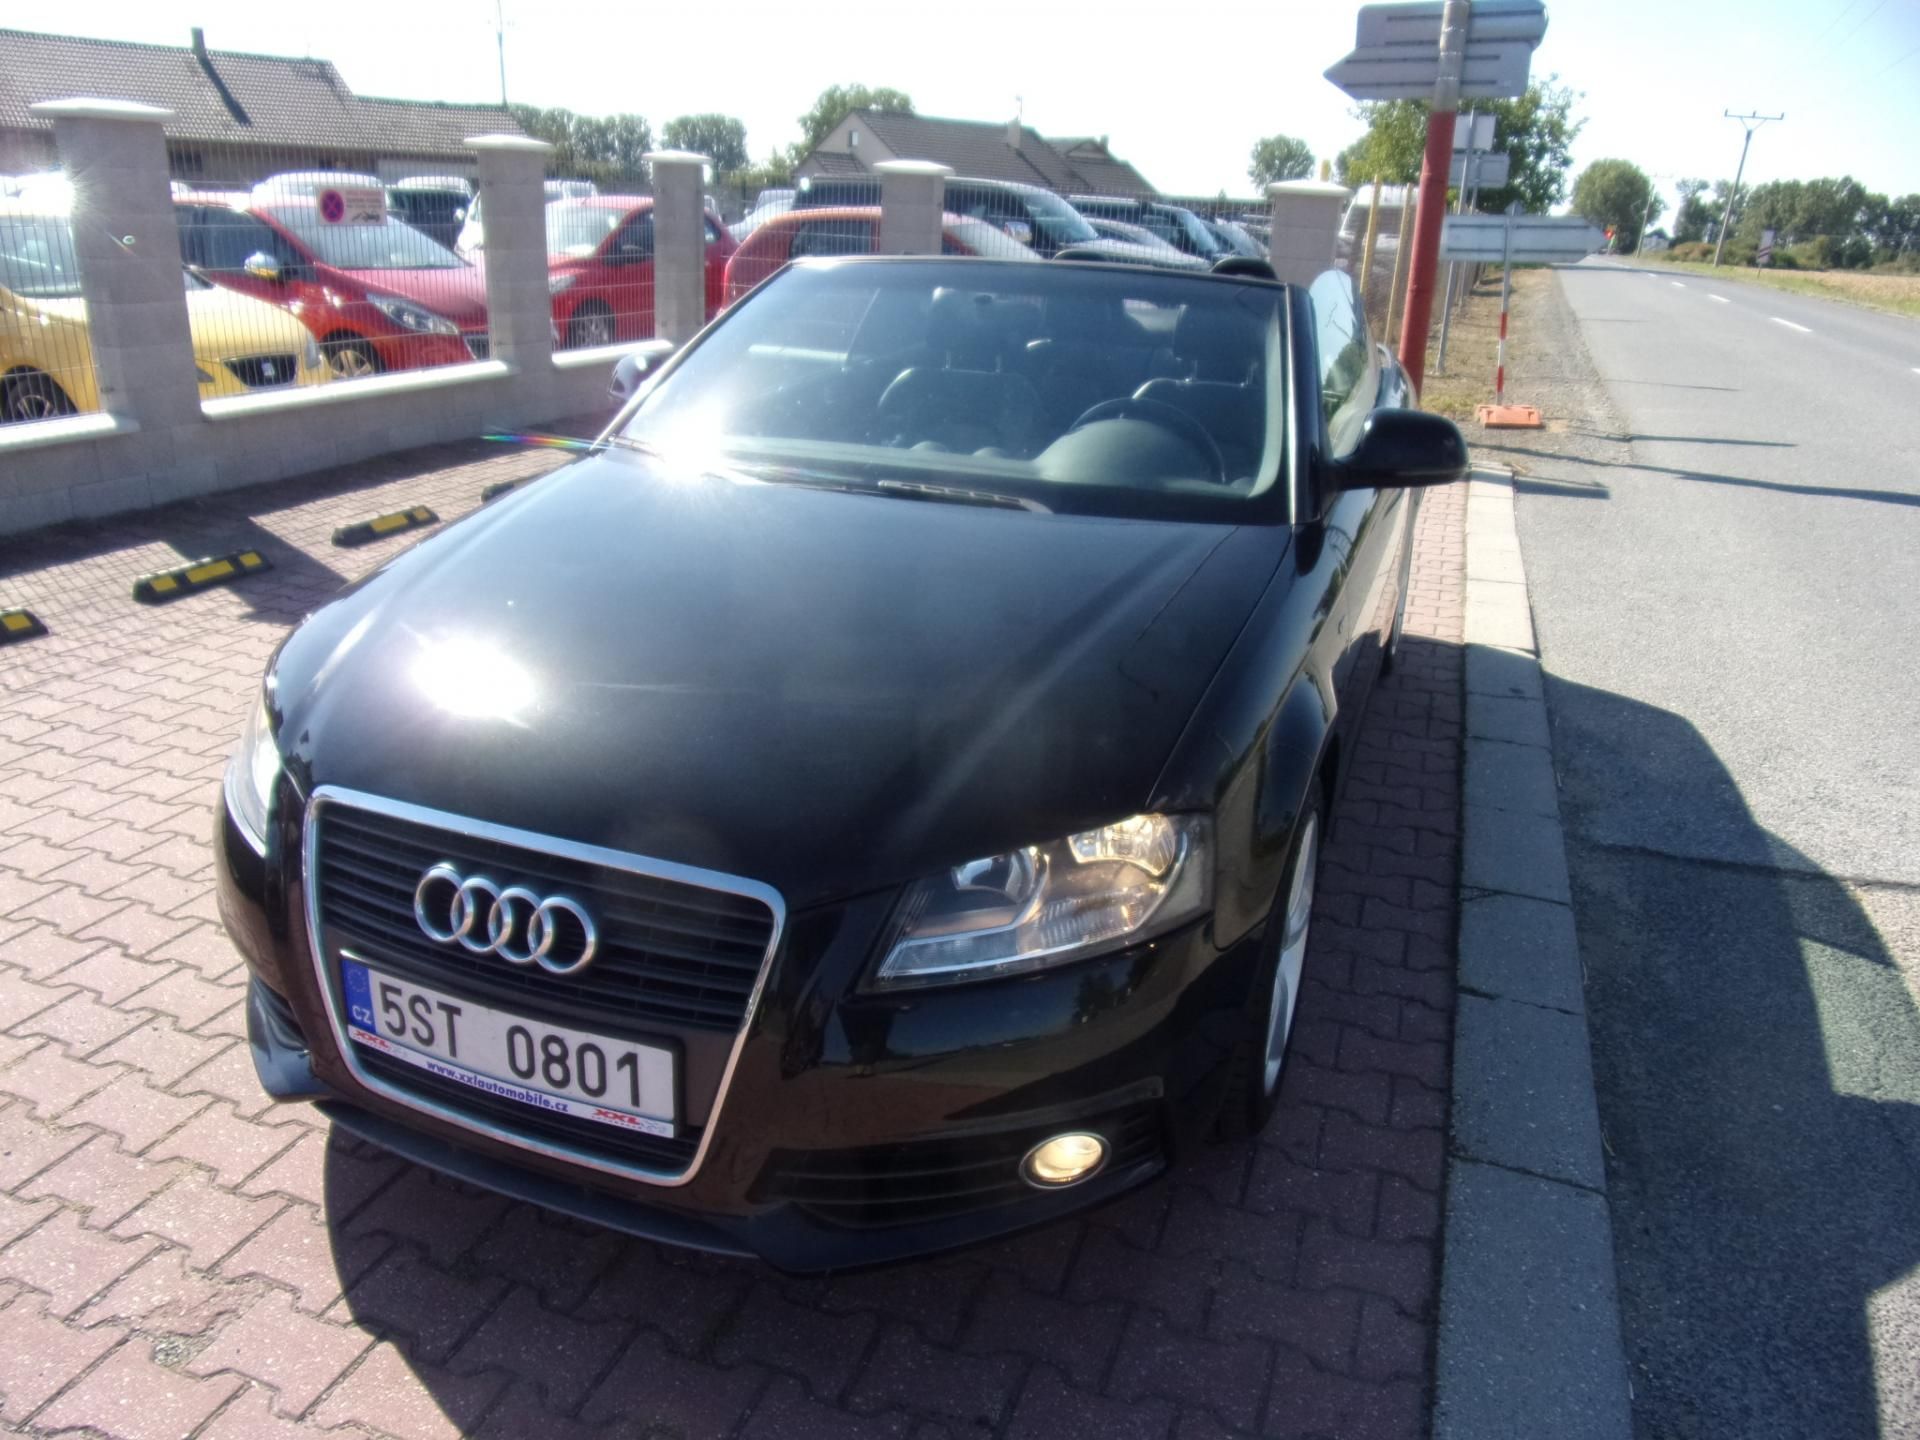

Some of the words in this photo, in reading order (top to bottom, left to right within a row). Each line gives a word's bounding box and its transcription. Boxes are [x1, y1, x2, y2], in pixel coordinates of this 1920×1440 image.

[352, 1004, 372, 1025] CZ
[379, 981, 462, 1058] 5ST
[506, 1024, 641, 1108] 0801
[426, 1060, 569, 1113] www.xxlautomobile.cz
[593, 1108, 641, 1126] XXL
